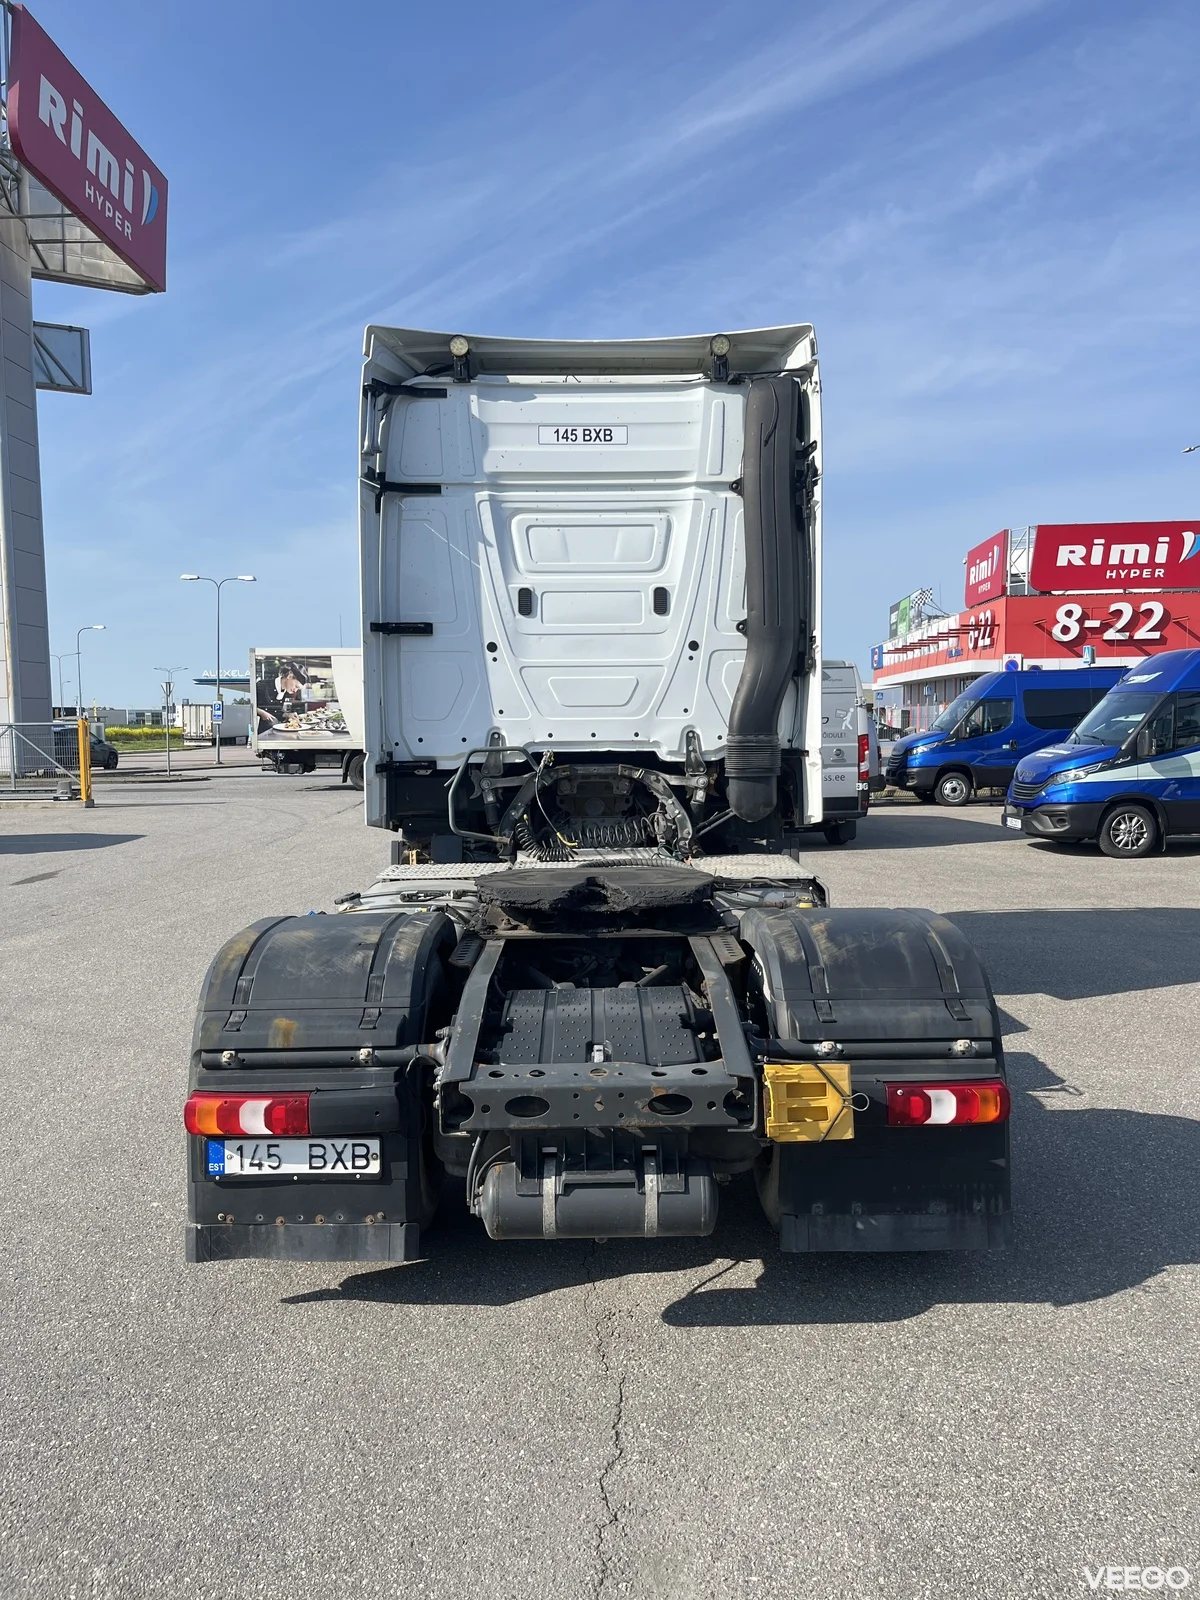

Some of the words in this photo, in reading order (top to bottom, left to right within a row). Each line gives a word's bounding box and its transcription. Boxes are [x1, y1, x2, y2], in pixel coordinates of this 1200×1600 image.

[38, 73, 136, 214] Rimi
[84, 179, 133, 242] HYPER
[553, 428, 578, 442] 145
[582, 428, 613, 442] BXB
[1055, 536, 1170, 567] Rimi
[969, 551, 993, 587] Rimi
[1105, 568, 1166, 580] HYPER
[977, 581, 991, 594] HYPER
[968, 609, 992, 650] 8-22
[1051, 600, 1165, 642] 8-22
[208, 1163, 224, 1172] EST
[236, 1143, 282, 1172] 145
[308, 1142, 371, 1171] BXB
